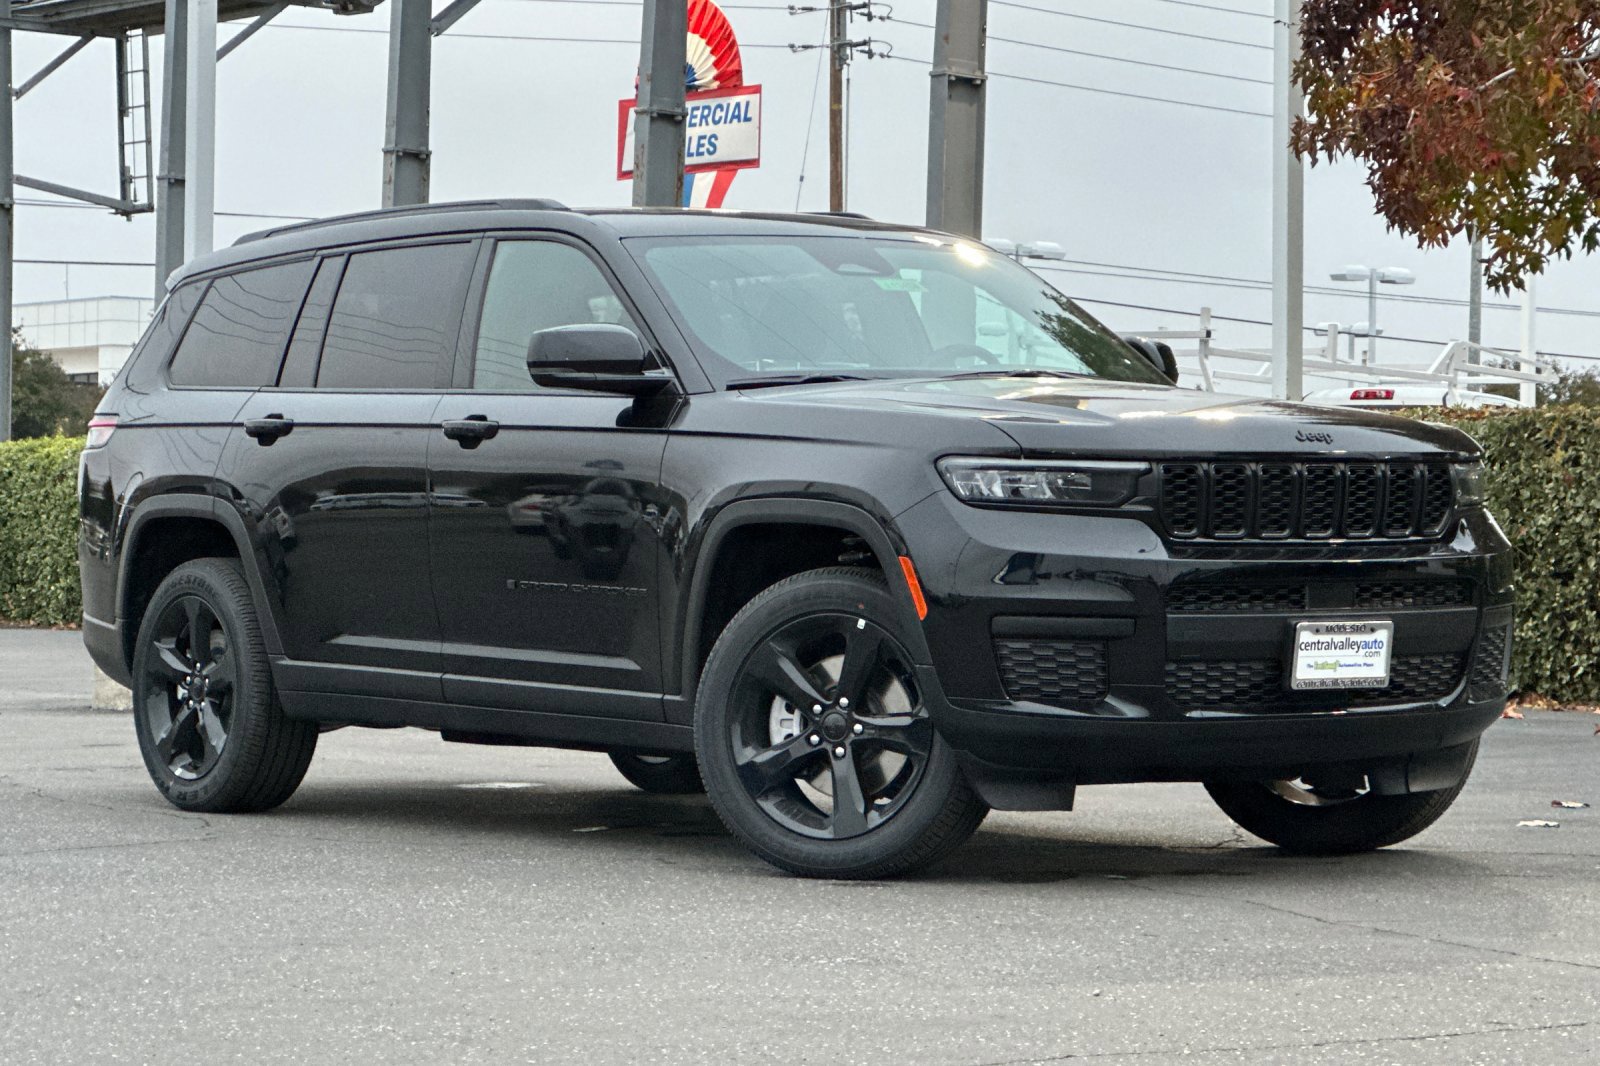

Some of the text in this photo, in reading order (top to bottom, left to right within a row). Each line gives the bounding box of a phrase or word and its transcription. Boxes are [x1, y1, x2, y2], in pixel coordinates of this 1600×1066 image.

[686, 100, 753, 128] ERCIAL
[686, 133, 719, 158] LES
[1295, 430, 1334, 445] Jeep
[1325, 624, 1367, 633] MODESTO
[1299, 637, 1384, 653] centralvalleyauto
